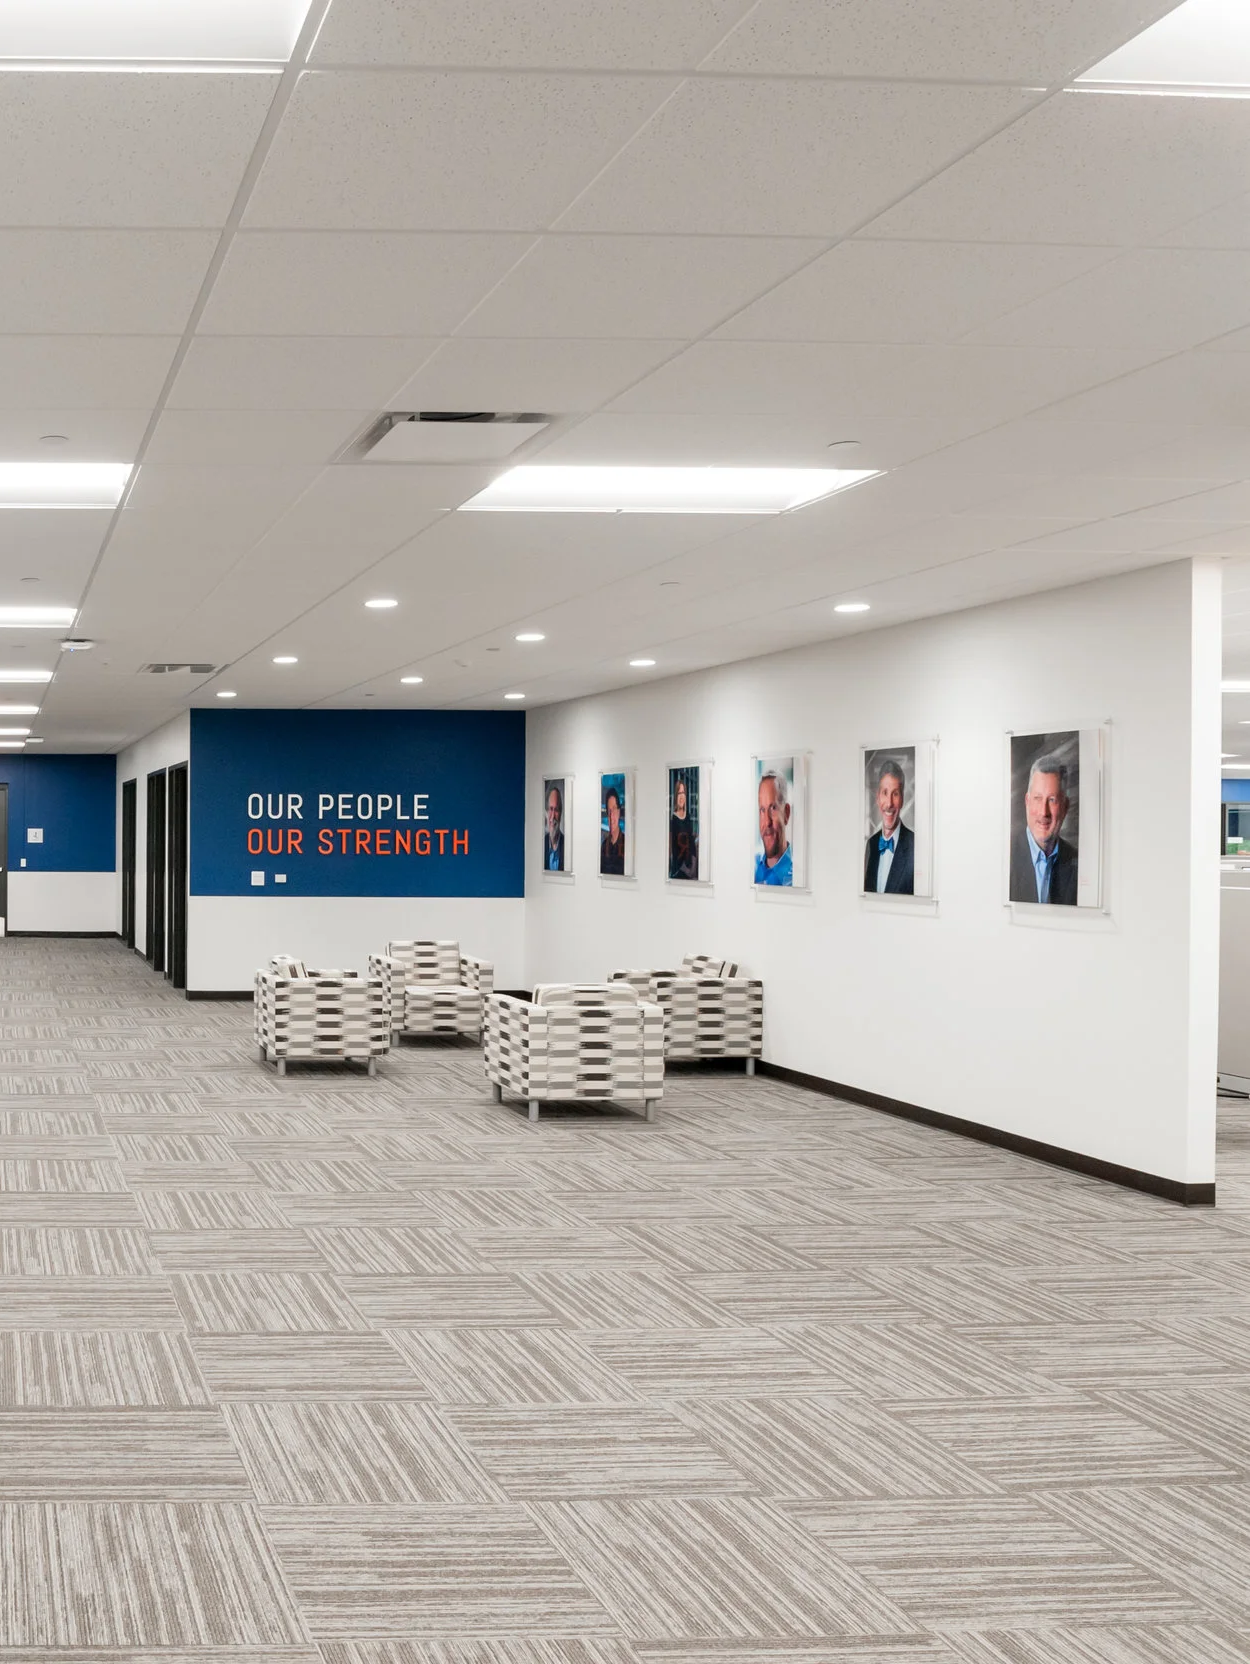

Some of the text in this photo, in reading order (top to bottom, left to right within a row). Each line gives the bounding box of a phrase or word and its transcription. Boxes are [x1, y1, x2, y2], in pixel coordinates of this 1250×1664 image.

[247, 793, 430, 820] OUR PEOPLE
[247, 828, 469, 855] OUR STRENGTH
